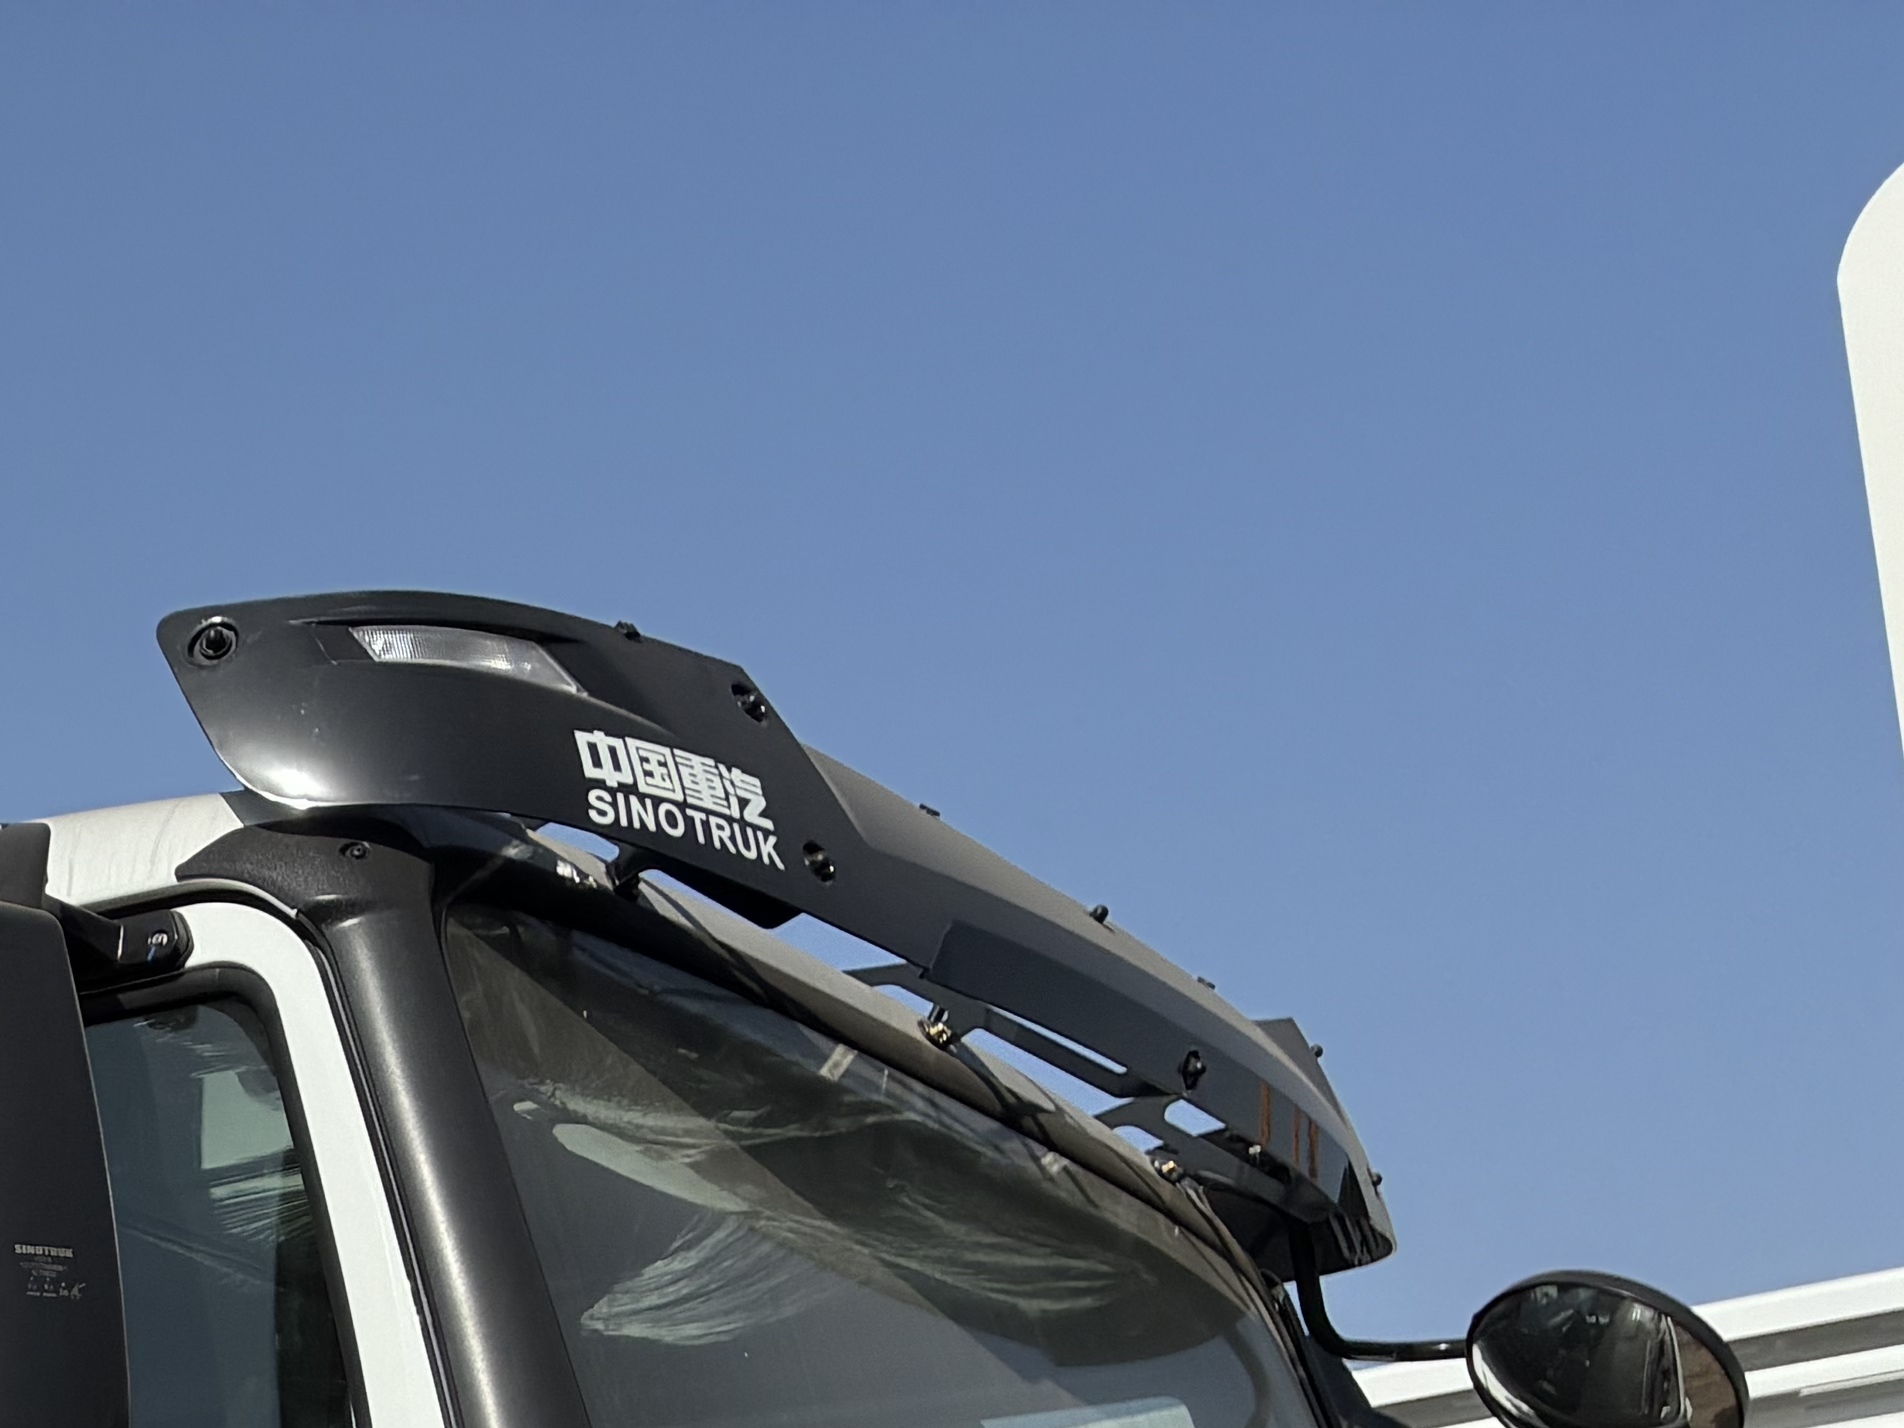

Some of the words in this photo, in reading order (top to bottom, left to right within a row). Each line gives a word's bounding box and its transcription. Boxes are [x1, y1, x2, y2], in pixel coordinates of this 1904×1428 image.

[573, 729, 775, 831] 中国重汽
[587, 788, 785, 871] SINOTRUK
